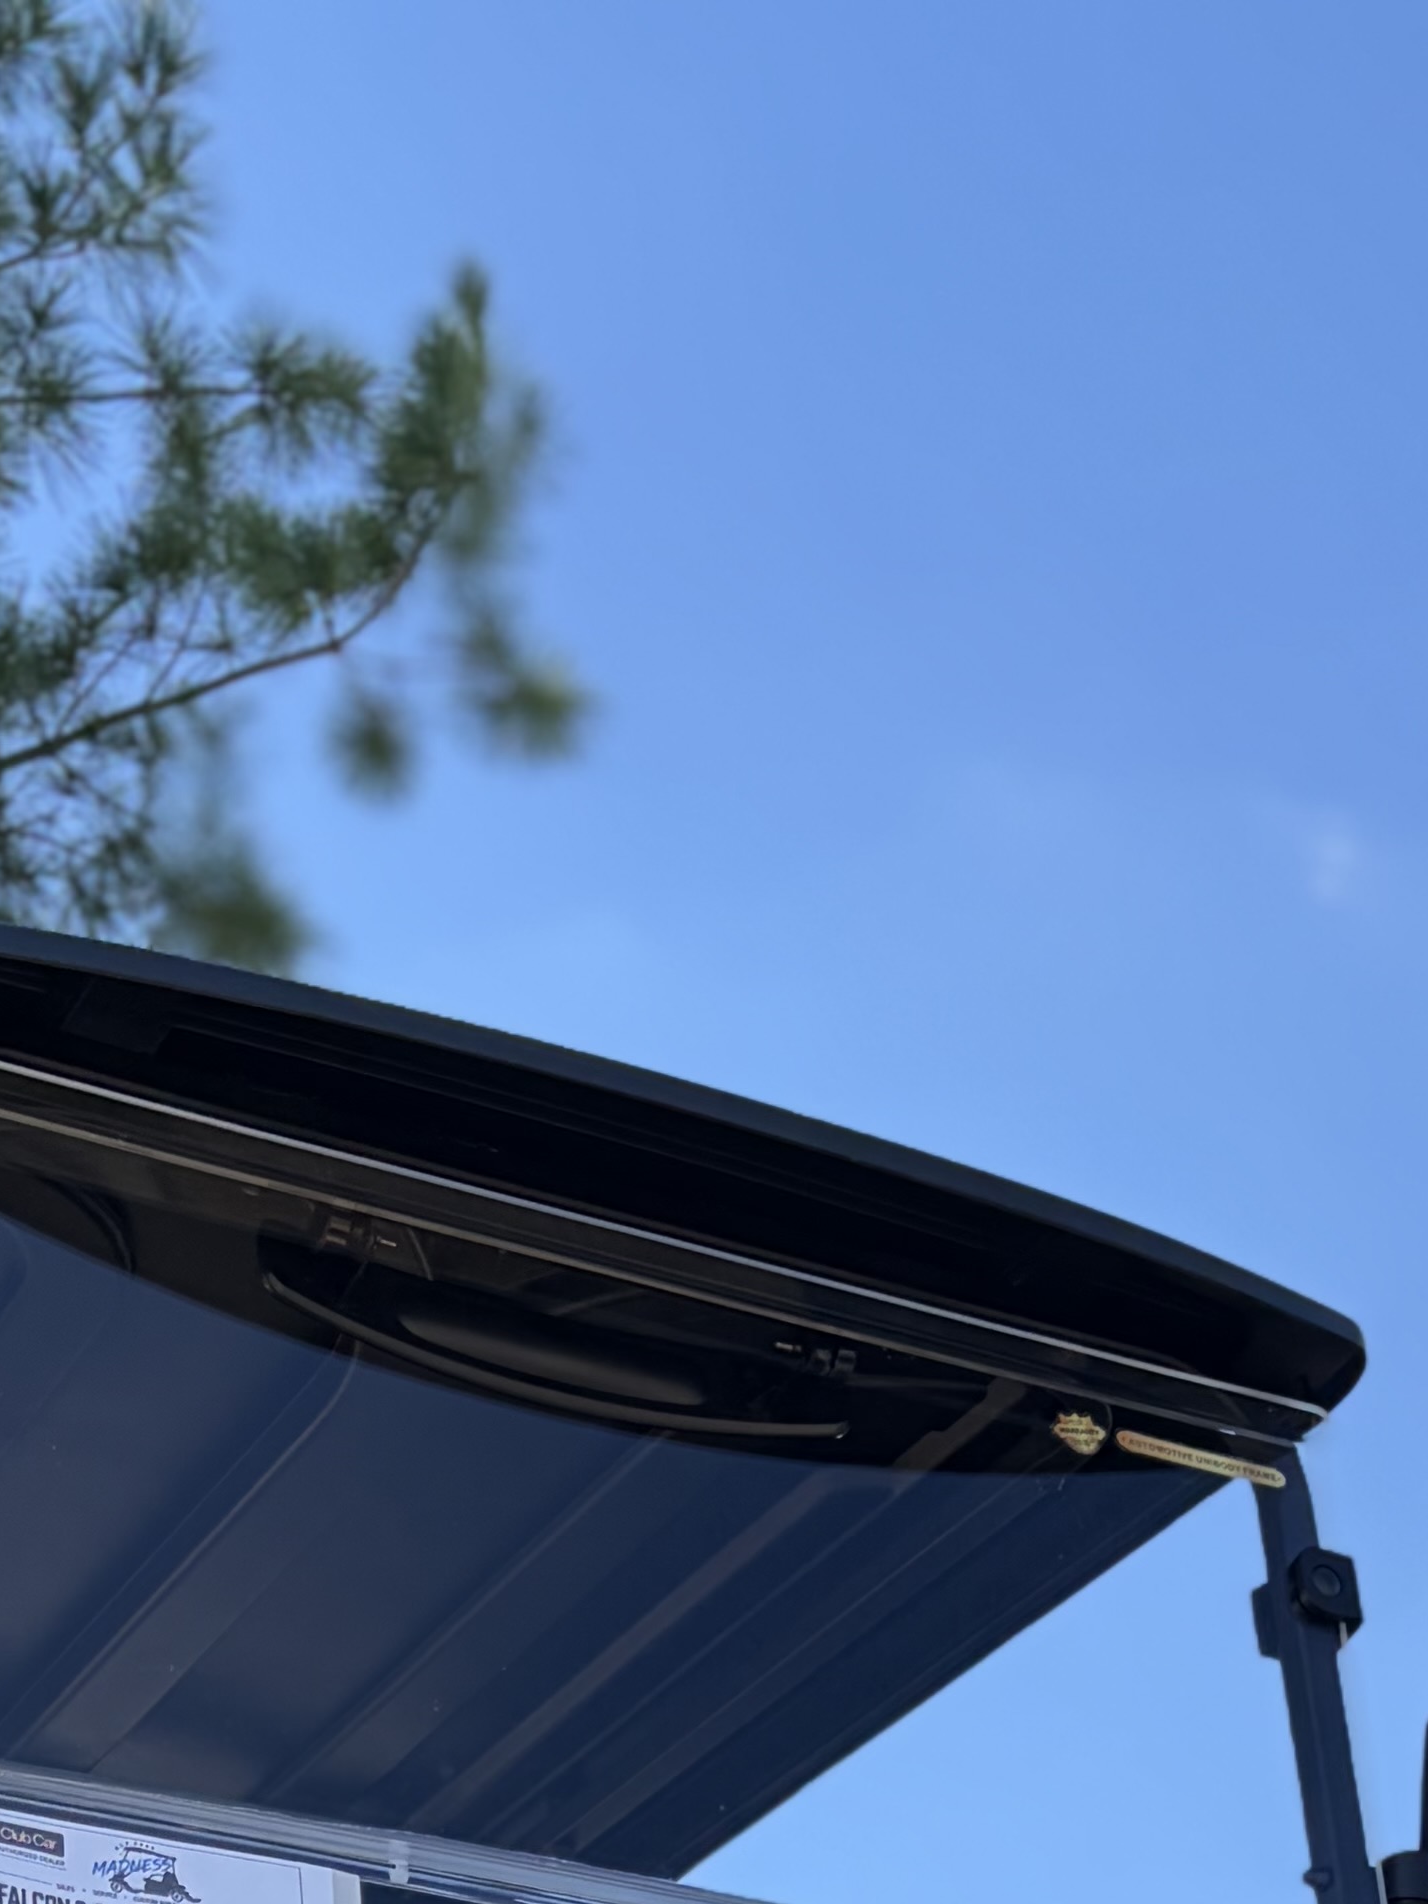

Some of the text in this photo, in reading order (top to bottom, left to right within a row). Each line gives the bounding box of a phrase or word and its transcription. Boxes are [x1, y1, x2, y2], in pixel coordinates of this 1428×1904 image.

[0, 1827, 58, 1850] Club Car
[92, 1857, 170, 1878] MADNESS
